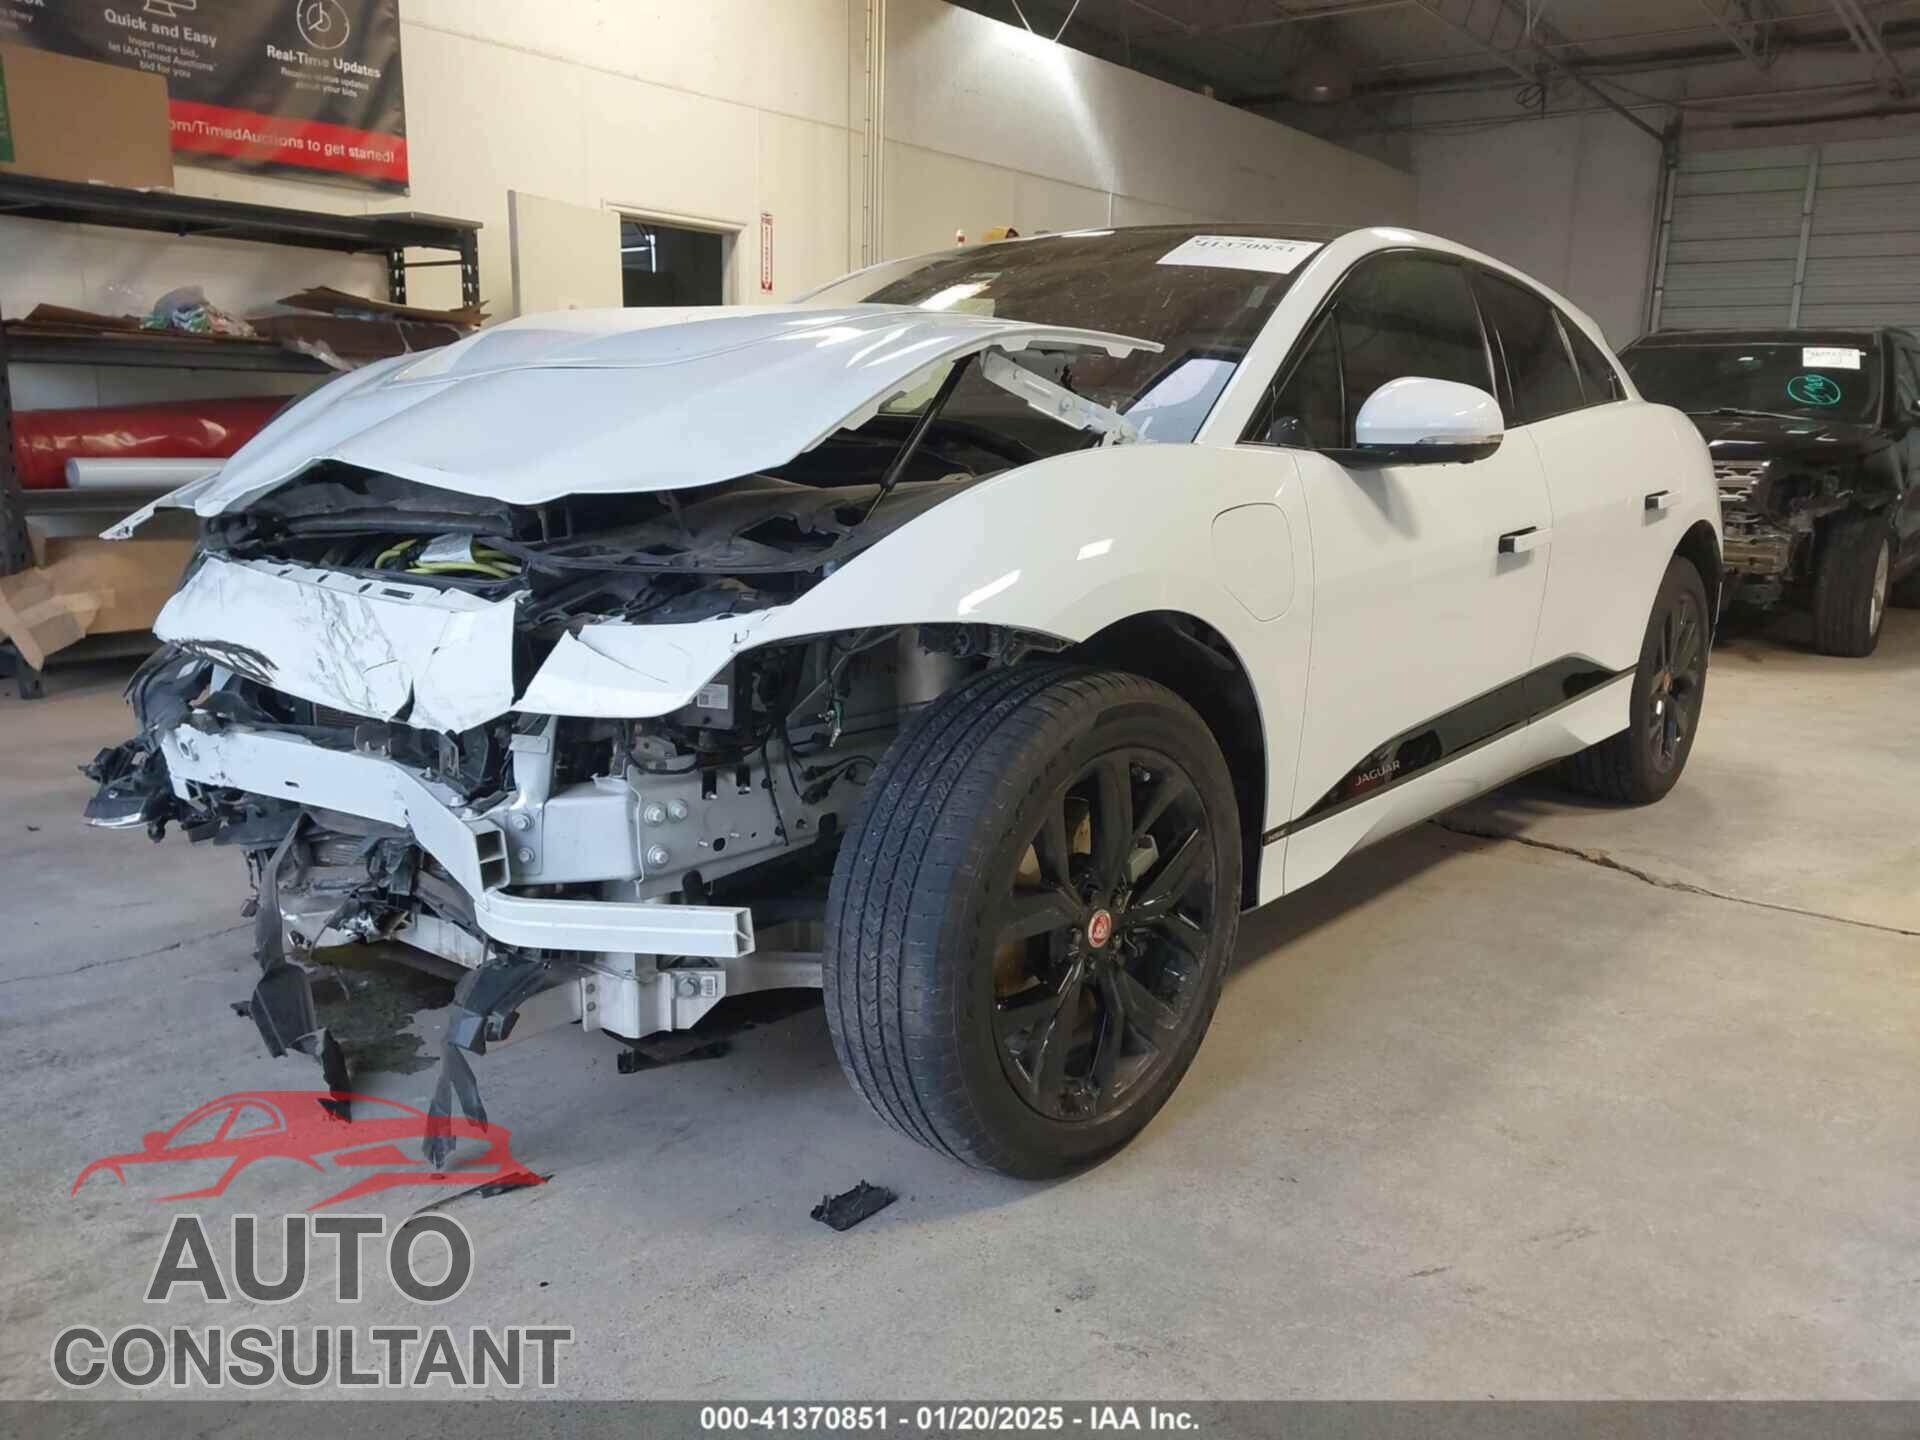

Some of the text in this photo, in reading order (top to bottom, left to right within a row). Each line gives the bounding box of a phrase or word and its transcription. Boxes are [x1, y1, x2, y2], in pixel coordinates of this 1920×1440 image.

[104, 8, 217, 48] Quick and Easy
[266, 44, 330, 68] Real-Time
[333, 57, 382, 78] Updates
[307, 139, 321, 152] to
[324, 143, 345, 157] get
[348, 146, 395, 163] started!
[1355, 759, 1400, 786] JAGUAR
